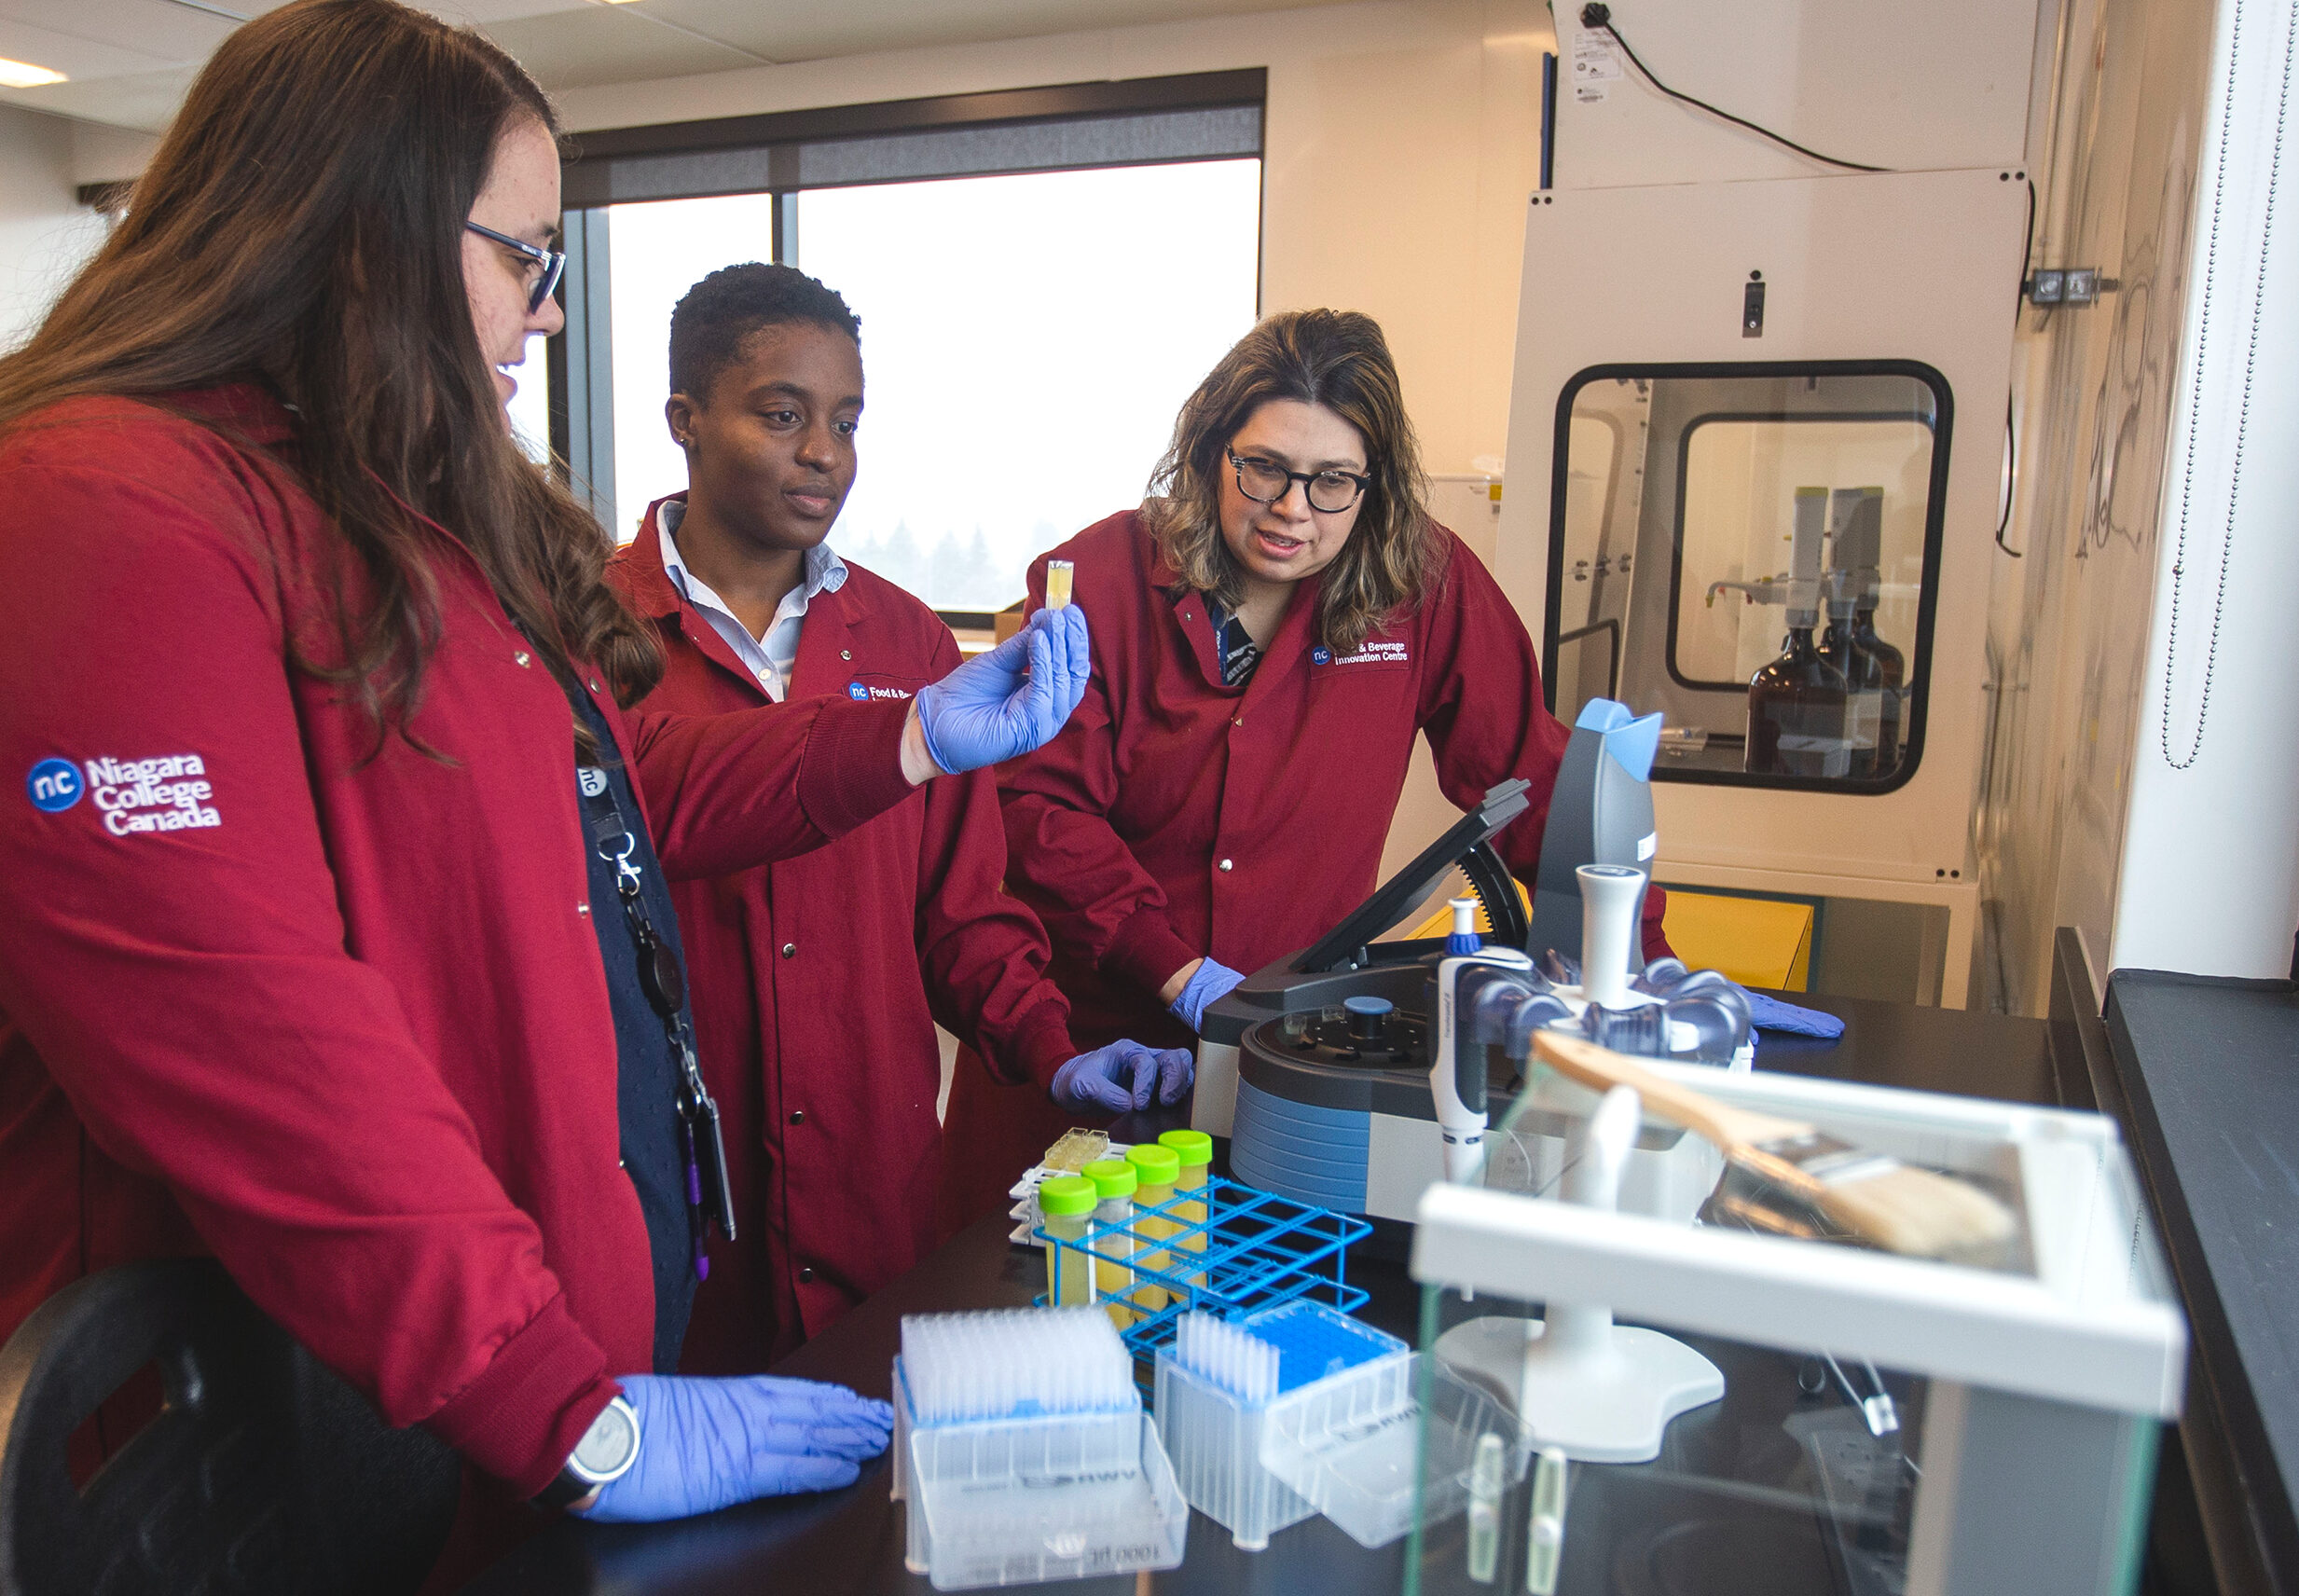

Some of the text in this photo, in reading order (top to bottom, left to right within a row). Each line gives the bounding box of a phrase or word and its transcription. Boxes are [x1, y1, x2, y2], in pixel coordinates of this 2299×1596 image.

[1315, 642, 1405, 661] nc & Beverage
[1335, 652, 1408, 666] Innovation Centre
[852, 687, 866, 697] nc
[869, 686, 891, 698] Food
[891, 688, 898, 698] &
[34, 754, 205, 800] nc Niagara
[581, 770, 599, 791] nc
[93, 780, 213, 811] College
[104, 805, 222, 836] Canada
